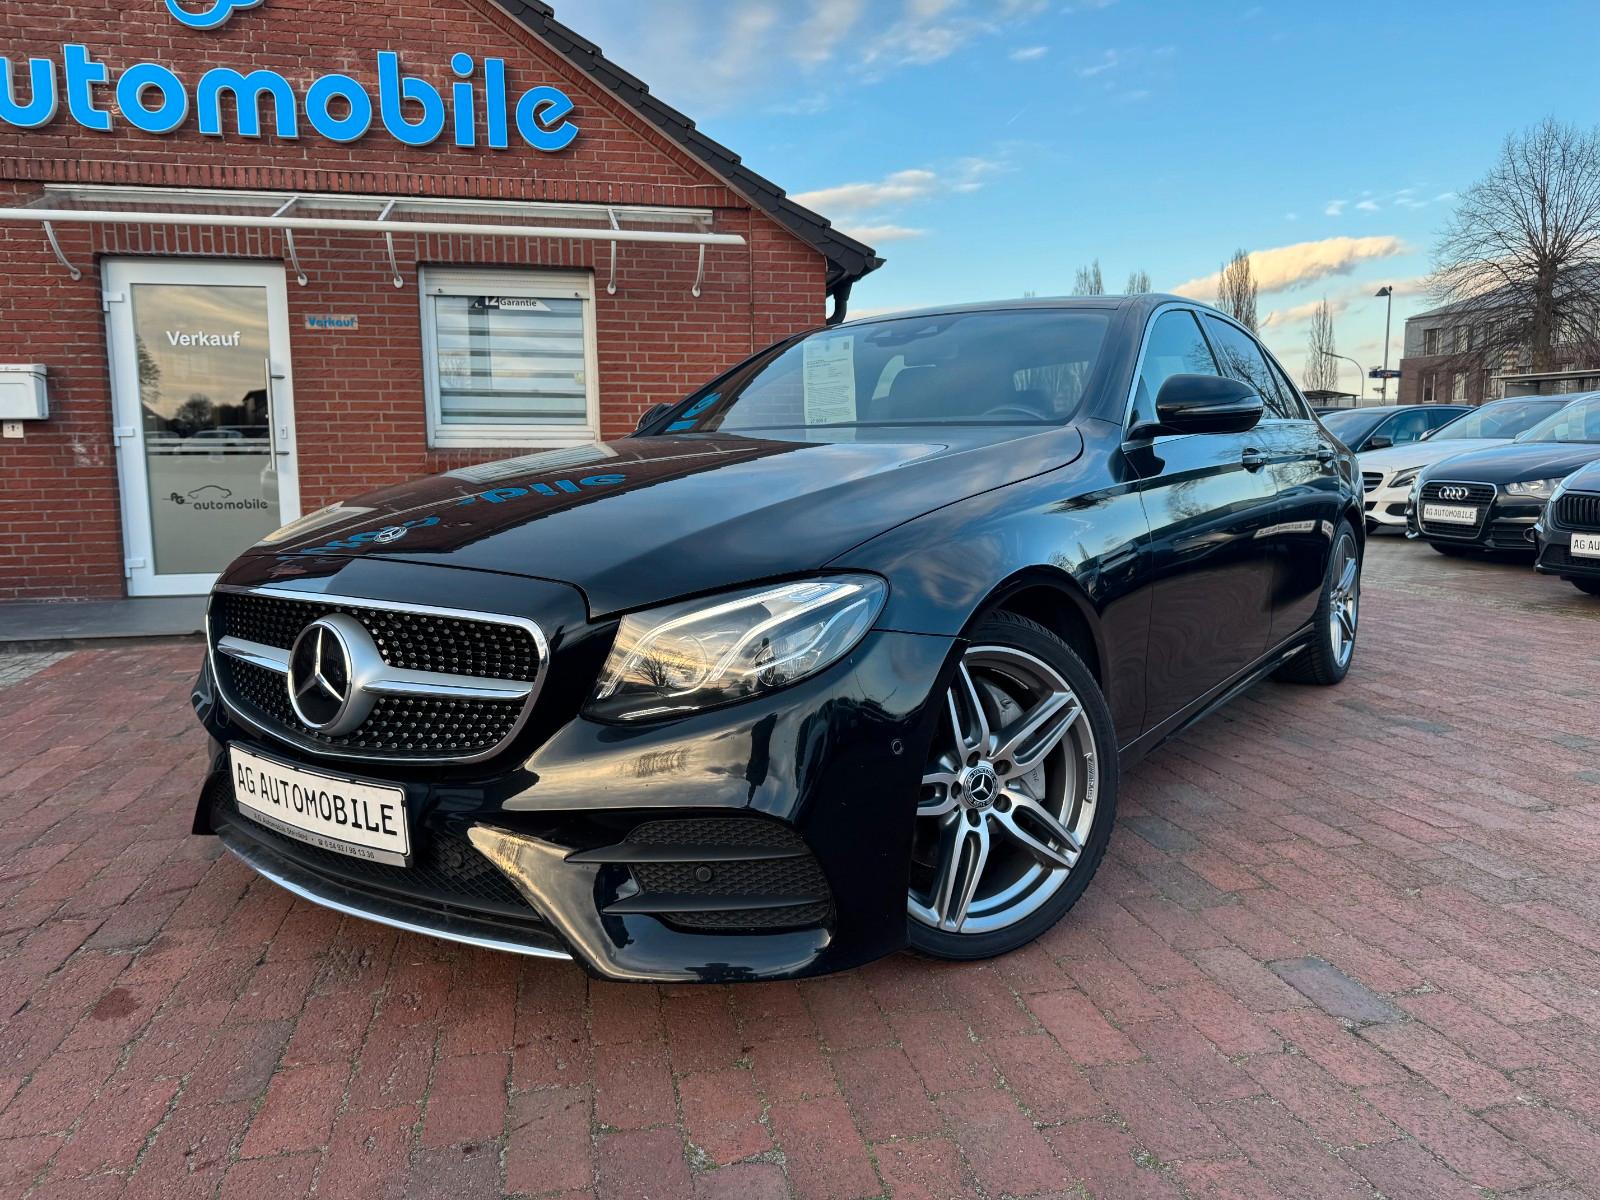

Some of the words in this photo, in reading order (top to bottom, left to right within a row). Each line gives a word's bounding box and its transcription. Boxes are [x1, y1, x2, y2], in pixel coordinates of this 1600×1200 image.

[500, 298, 537, 307] Garantie
[307, 316, 357, 328] Verkauf
[166, 331, 241, 346] Verkauf
[193, 499, 268, 510] automobile
[1434, 508, 1475, 519] AUTOMOBILE
[1573, 539, 1586, 549] AG
[236, 762, 256, 795] AG
[260, 772, 398, 836] AUTOMOBILE
